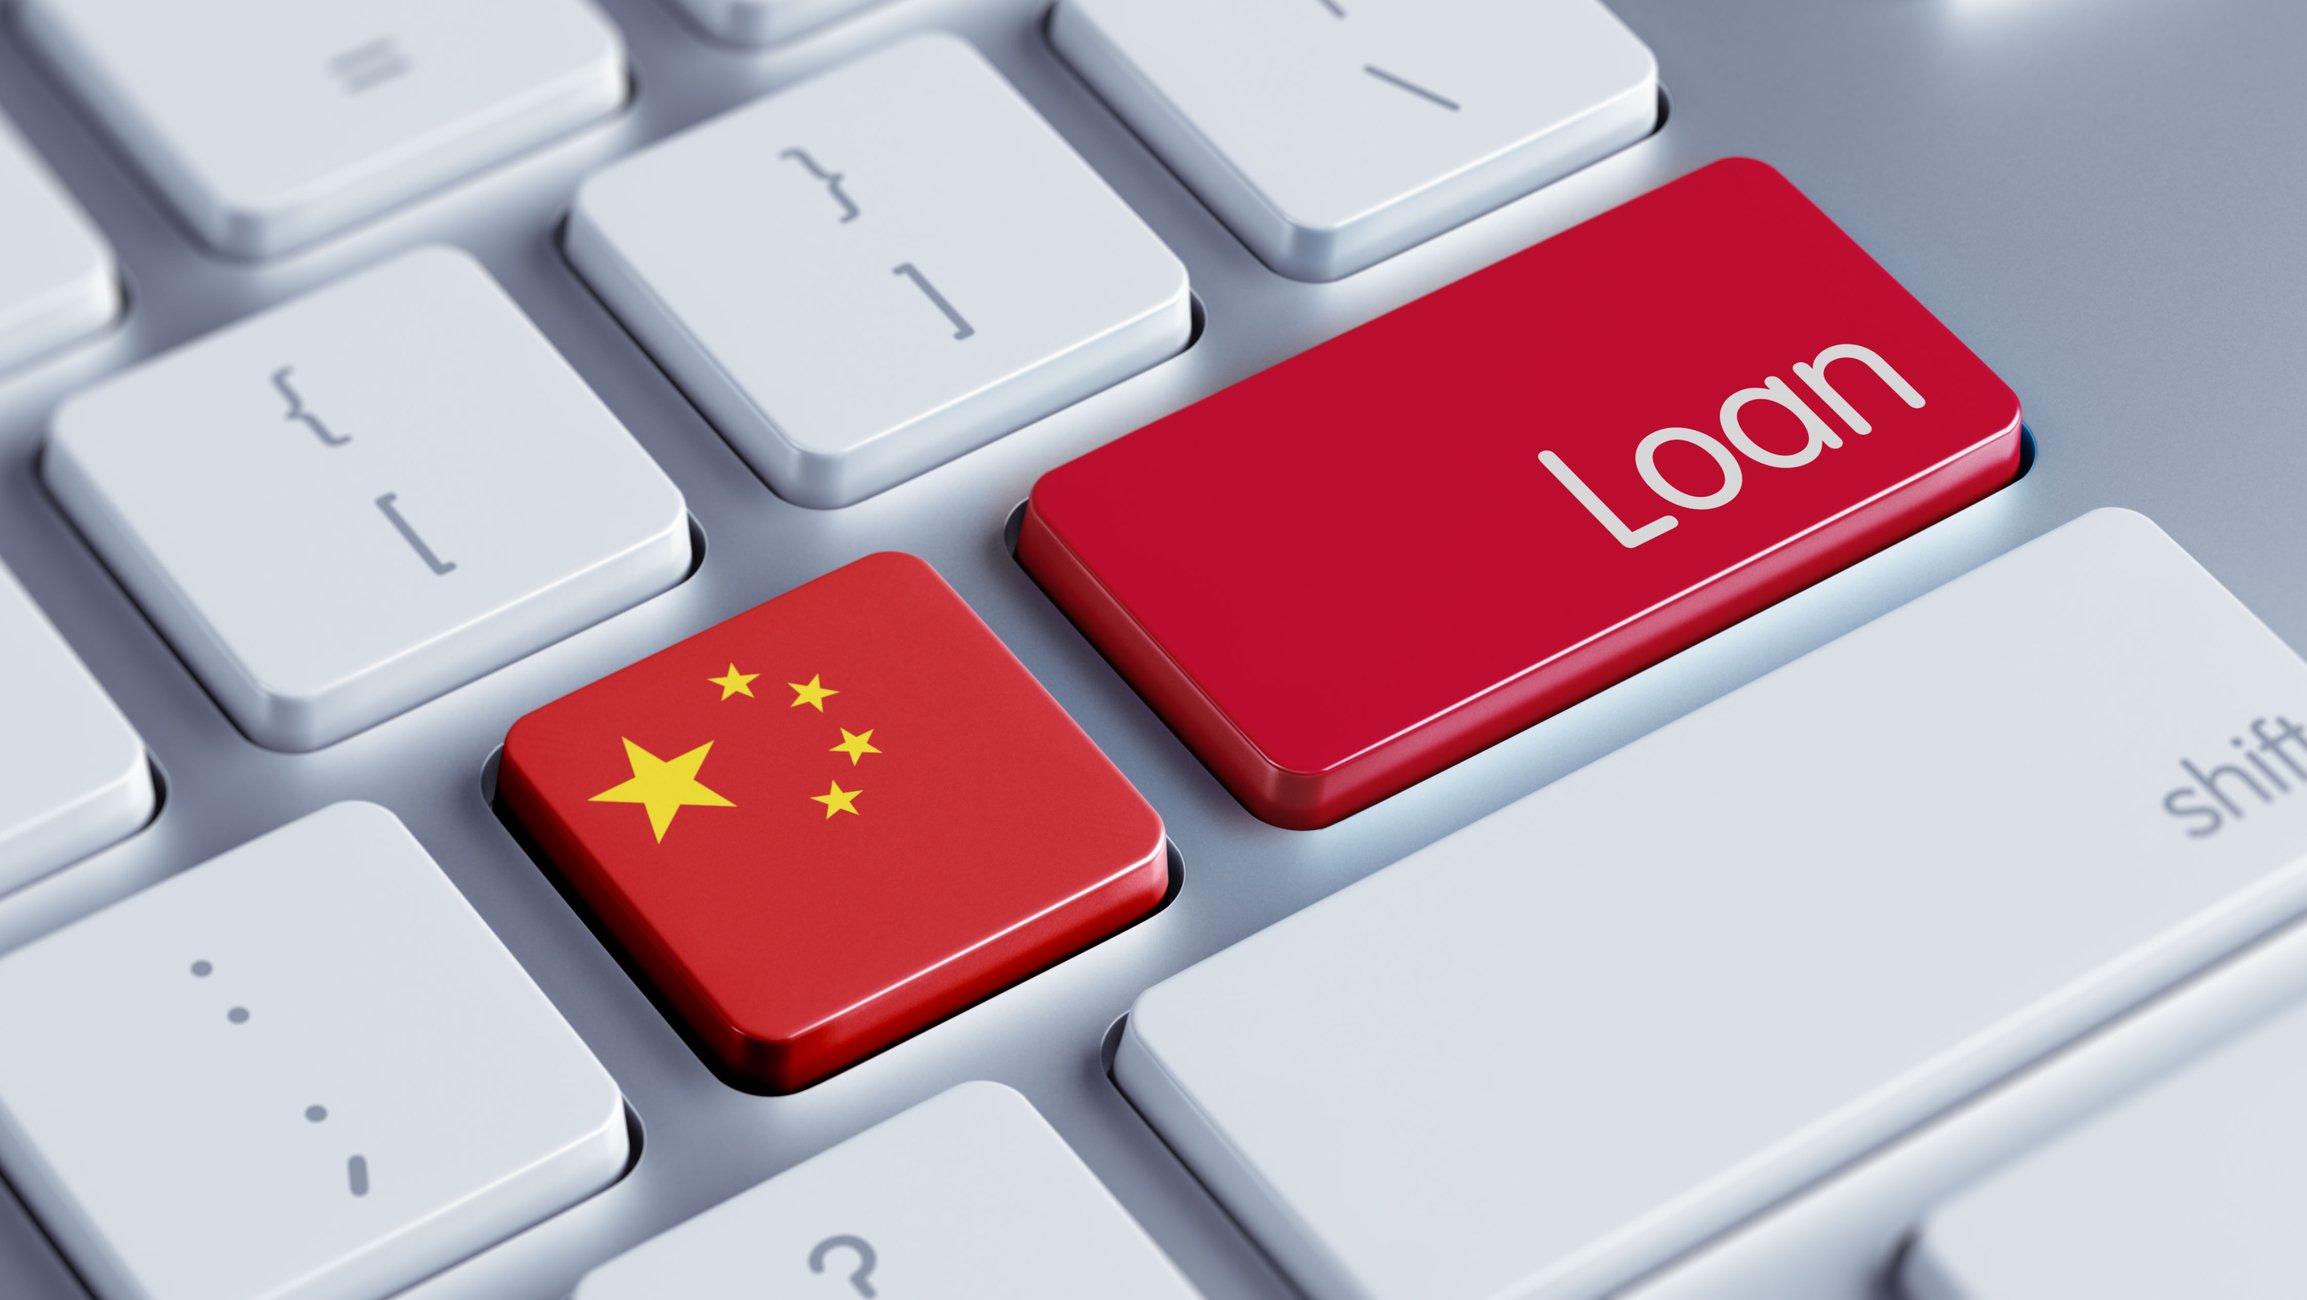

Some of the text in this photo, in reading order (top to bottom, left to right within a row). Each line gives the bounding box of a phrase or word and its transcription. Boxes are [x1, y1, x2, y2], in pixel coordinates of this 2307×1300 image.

[779, 147, 861, 224] }
[892, 262, 976, 341] ]
[270, 366, 352, 448] {
[1538, 344, 1926, 548] Loan
[374, 492, 458, 576] [
[2162, 716, 2307, 838] shift
